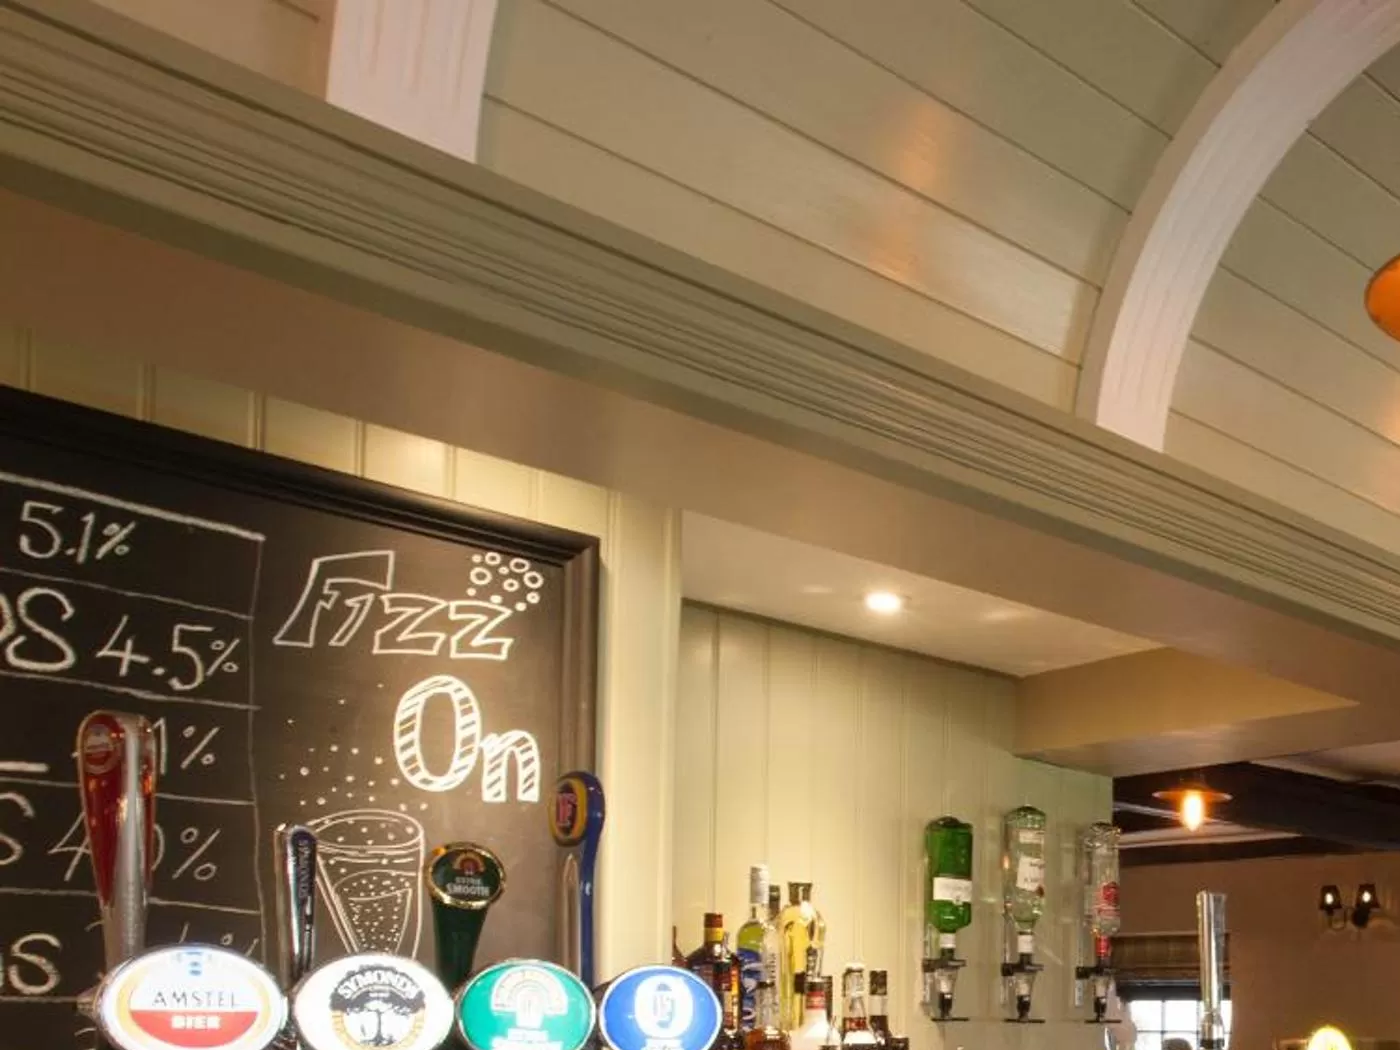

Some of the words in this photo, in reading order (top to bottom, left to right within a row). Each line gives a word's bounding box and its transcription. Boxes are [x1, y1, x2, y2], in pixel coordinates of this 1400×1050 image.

[19, 501, 137, 564] 5.1%
[0, 587, 76, 673] S
[96, 615, 239, 692] 4.5%
[394, 675, 540, 802] On
[152, 990, 239, 1008] AMSTEL
[171, 1015, 221, 1029] BIER
